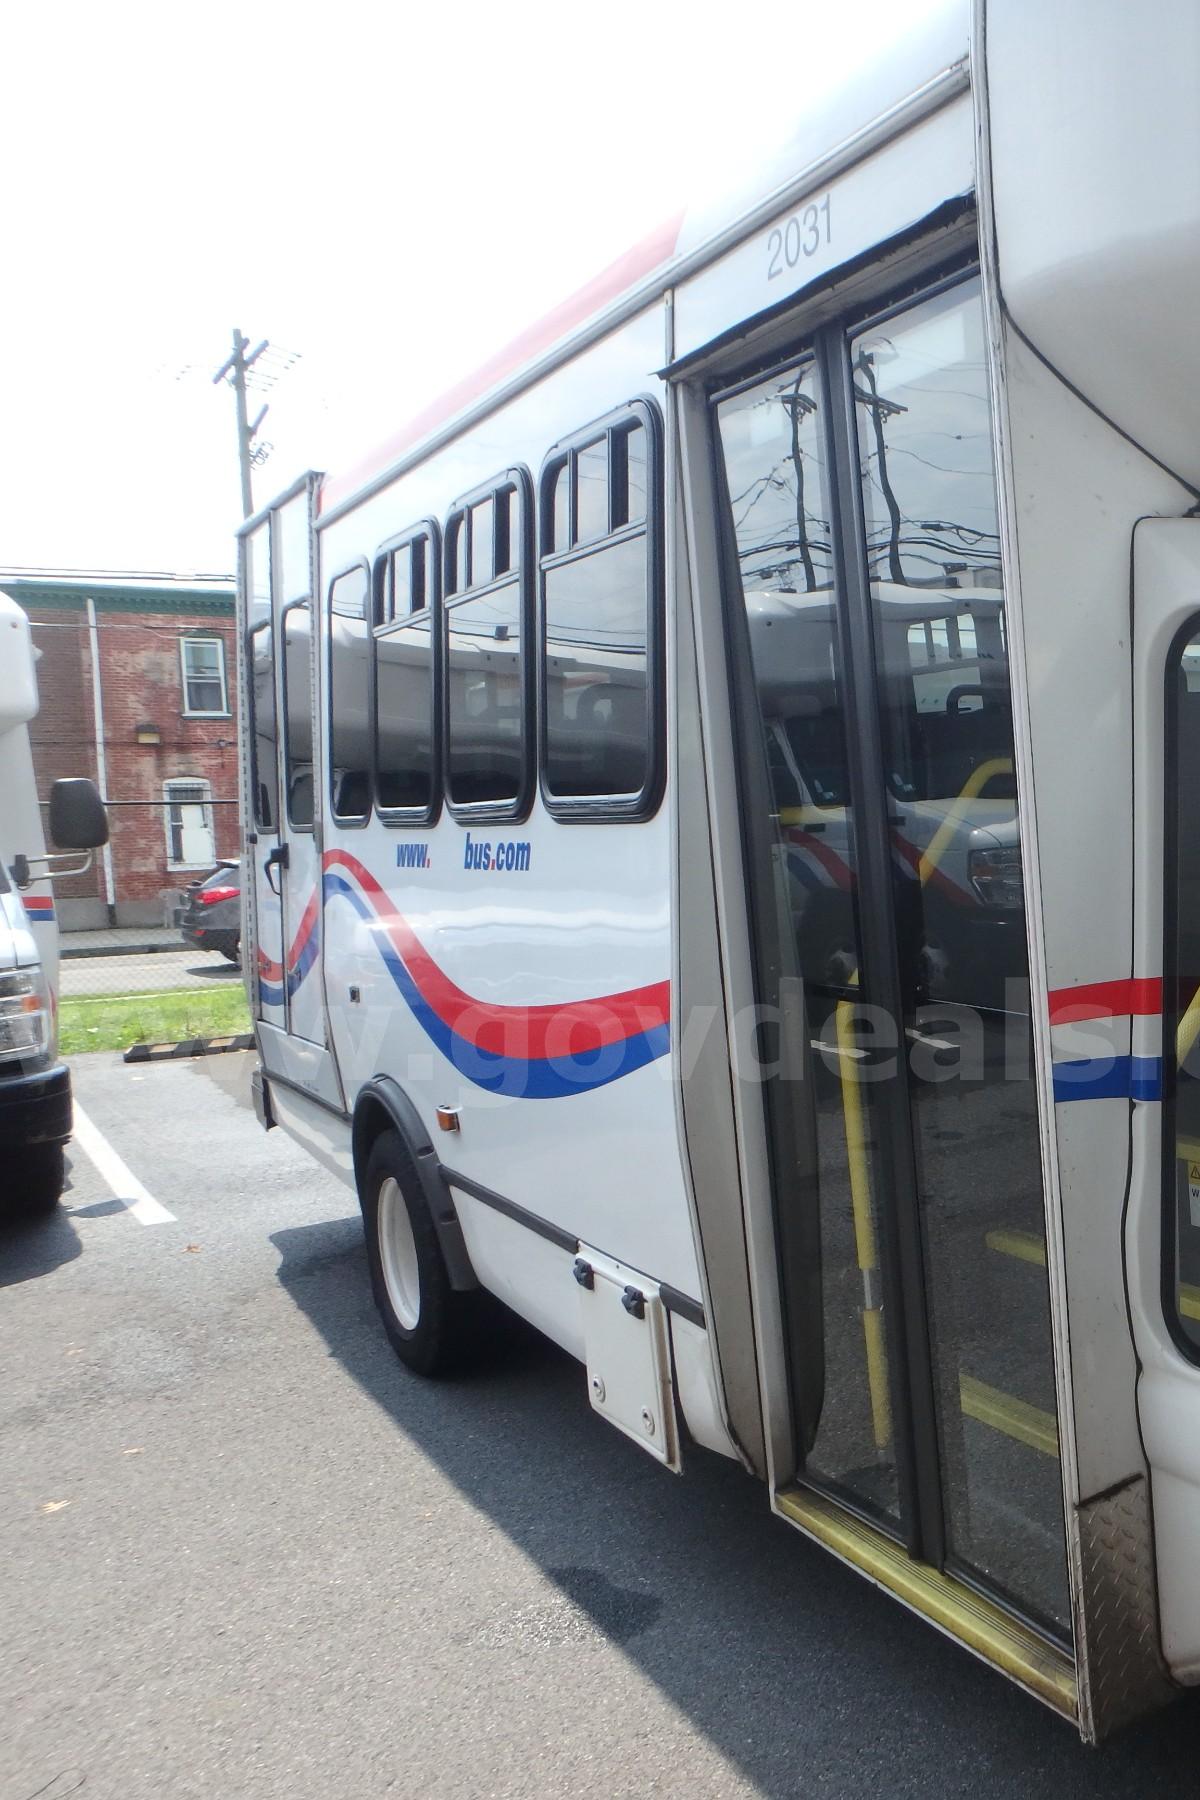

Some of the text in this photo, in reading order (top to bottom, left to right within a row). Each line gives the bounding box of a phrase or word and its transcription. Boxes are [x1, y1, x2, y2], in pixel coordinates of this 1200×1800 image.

[767, 192, 832, 282] 2031
[396, 832, 532, 872] www. bus.com
